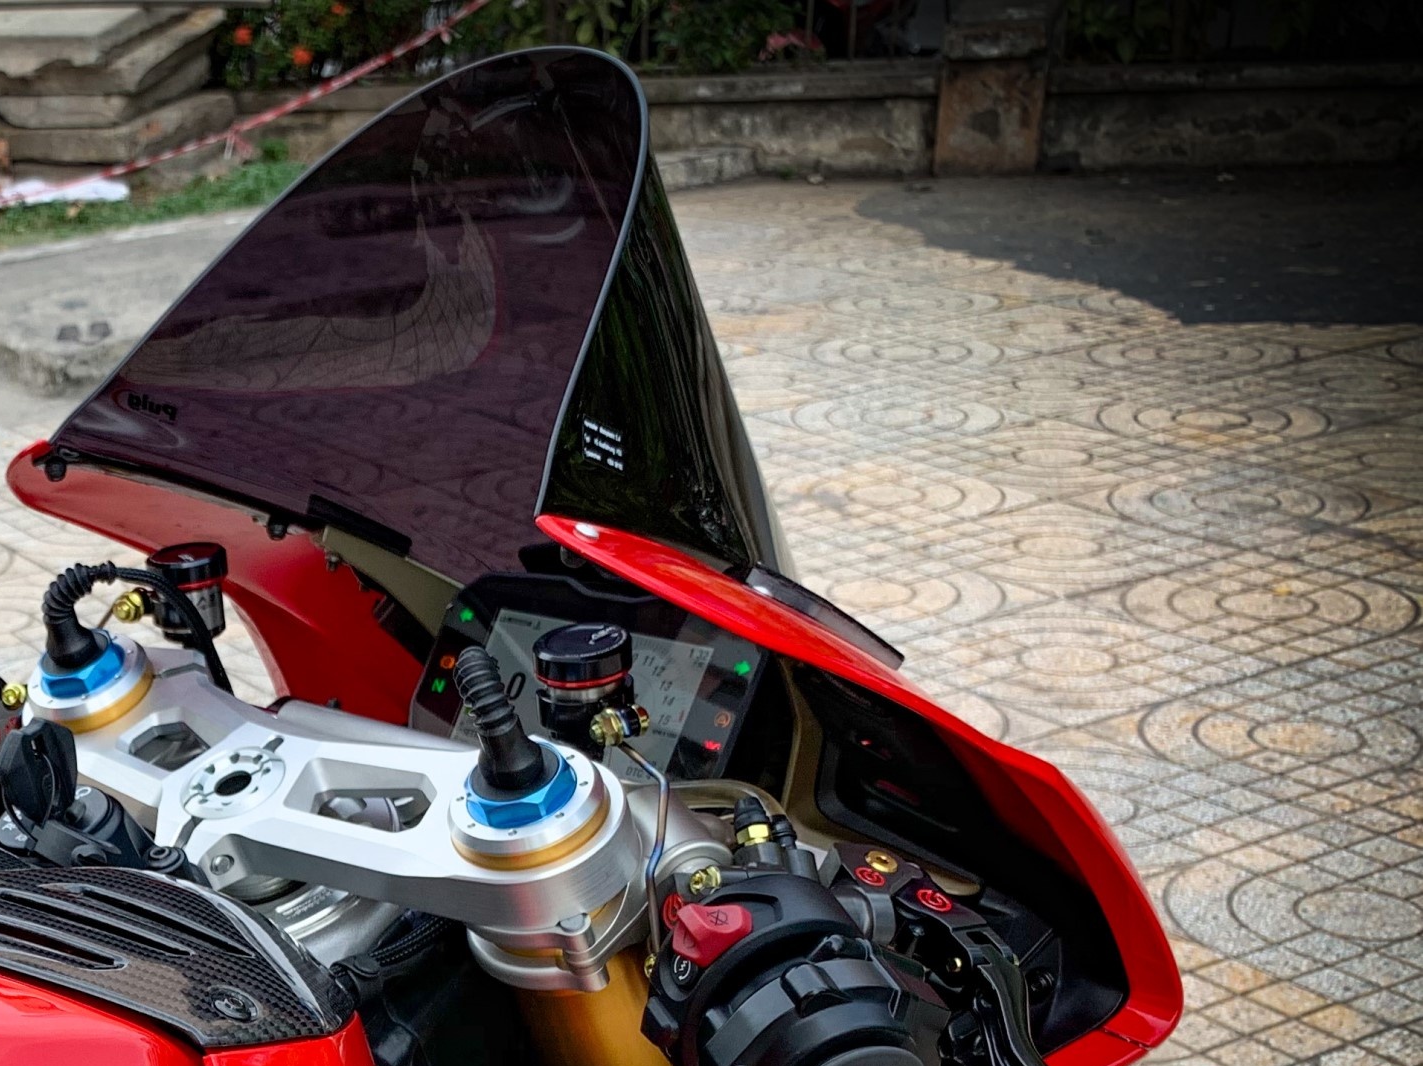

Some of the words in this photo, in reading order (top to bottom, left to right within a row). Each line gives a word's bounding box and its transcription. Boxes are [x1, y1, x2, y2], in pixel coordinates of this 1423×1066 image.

[643, 655, 655, 666] 11
[651, 666, 666, 677] 12
[431, 677, 447, 694] N
[659, 680, 673, 691] 13
[662, 695, 676, 706] 14
[658, 714, 672, 725] 15
